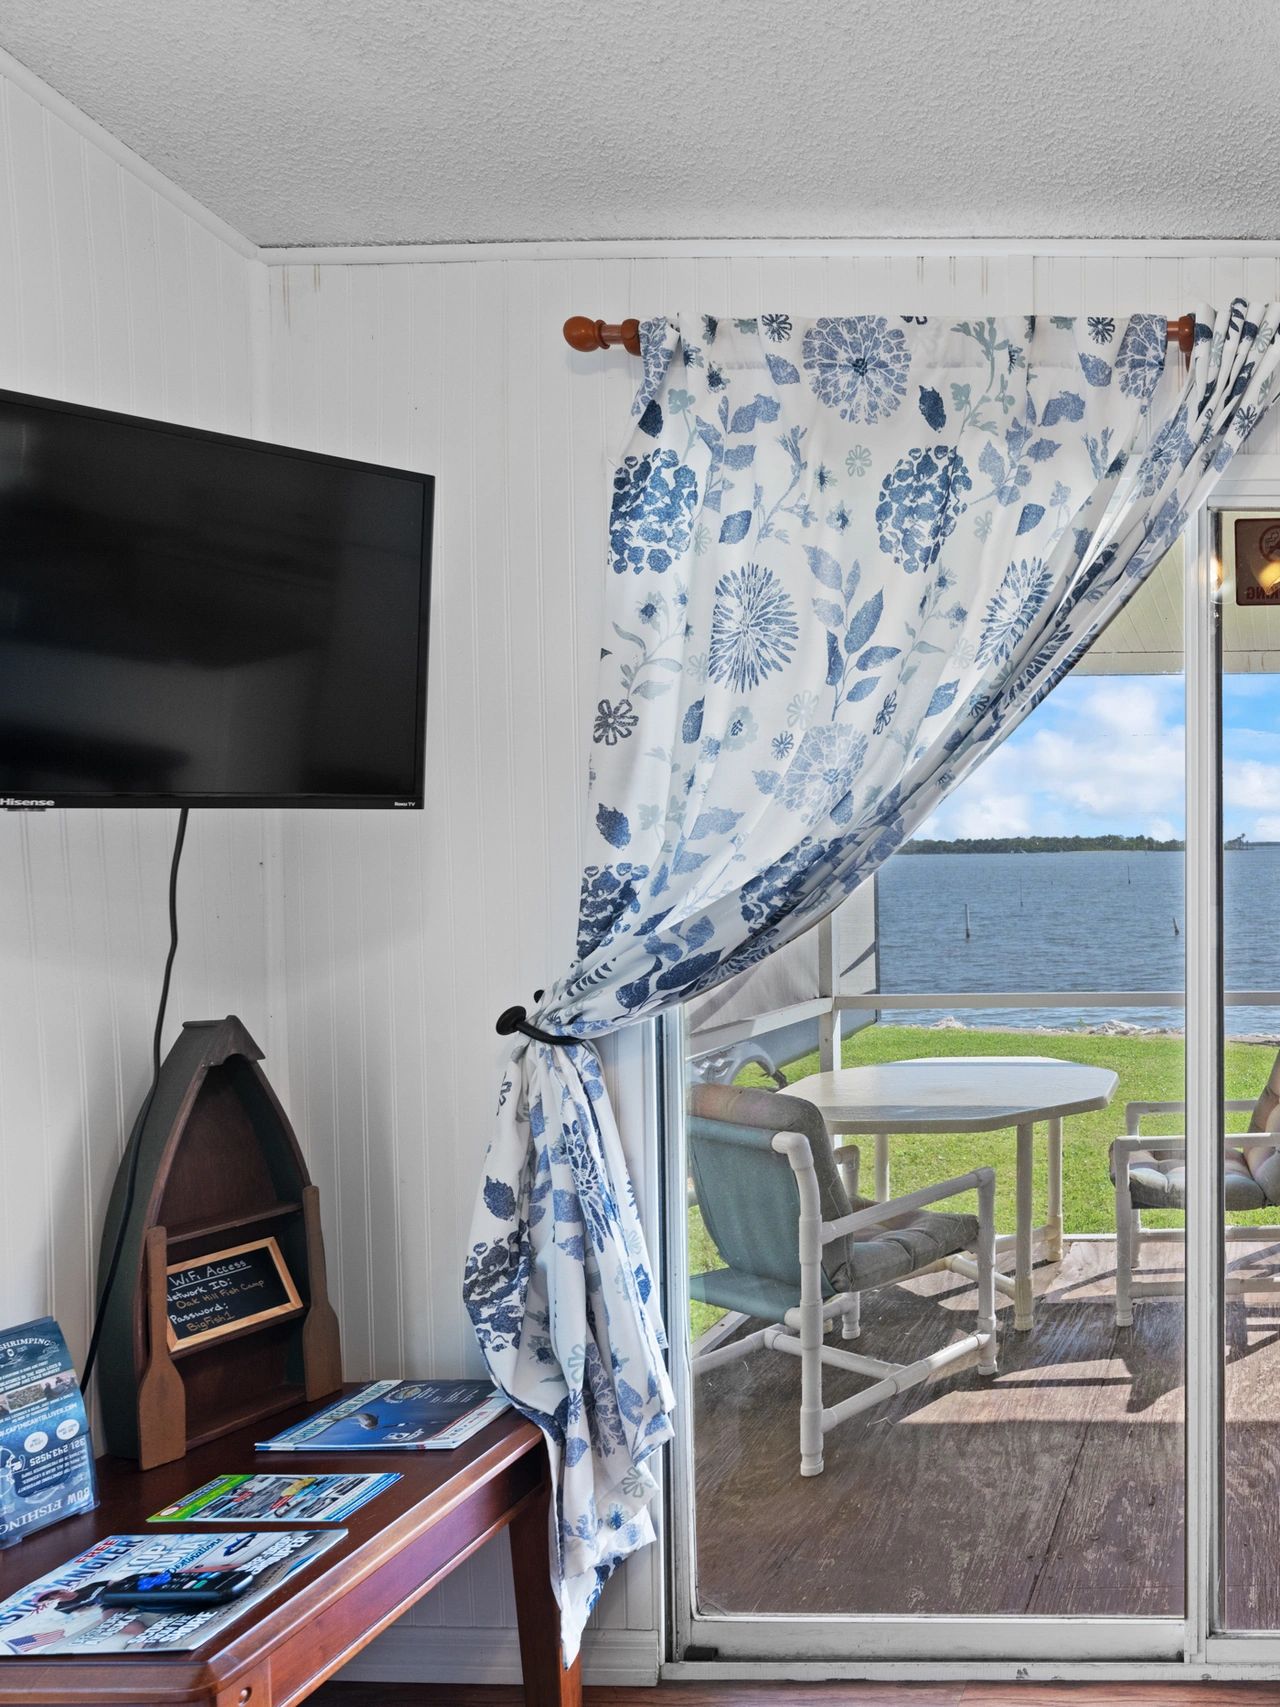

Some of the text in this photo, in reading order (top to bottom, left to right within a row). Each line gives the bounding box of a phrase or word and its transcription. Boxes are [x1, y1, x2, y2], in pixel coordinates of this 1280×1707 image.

[0, 797, 55, 807] Hisense
[206, 1260, 248, 1278] Access
[175, 1280, 265, 1309] Oak Hill Fish Camp
[208, 1277, 233, 1291] ID:
[169, 1302, 229, 1325] Password:
[0, 1337, 51, 1351] SHRIMPING
[0, 1486, 90, 1535] BOW FISHING
[52, 1539, 145, 1588] ANGLER
[73, 1538, 120, 1564] FREE
[115, 1544, 168, 1573] TOP
[139, 1539, 210, 1573] TUNA
[163, 1538, 223, 1574] Destinations
[158, 1610, 219, 1643] SHORE
